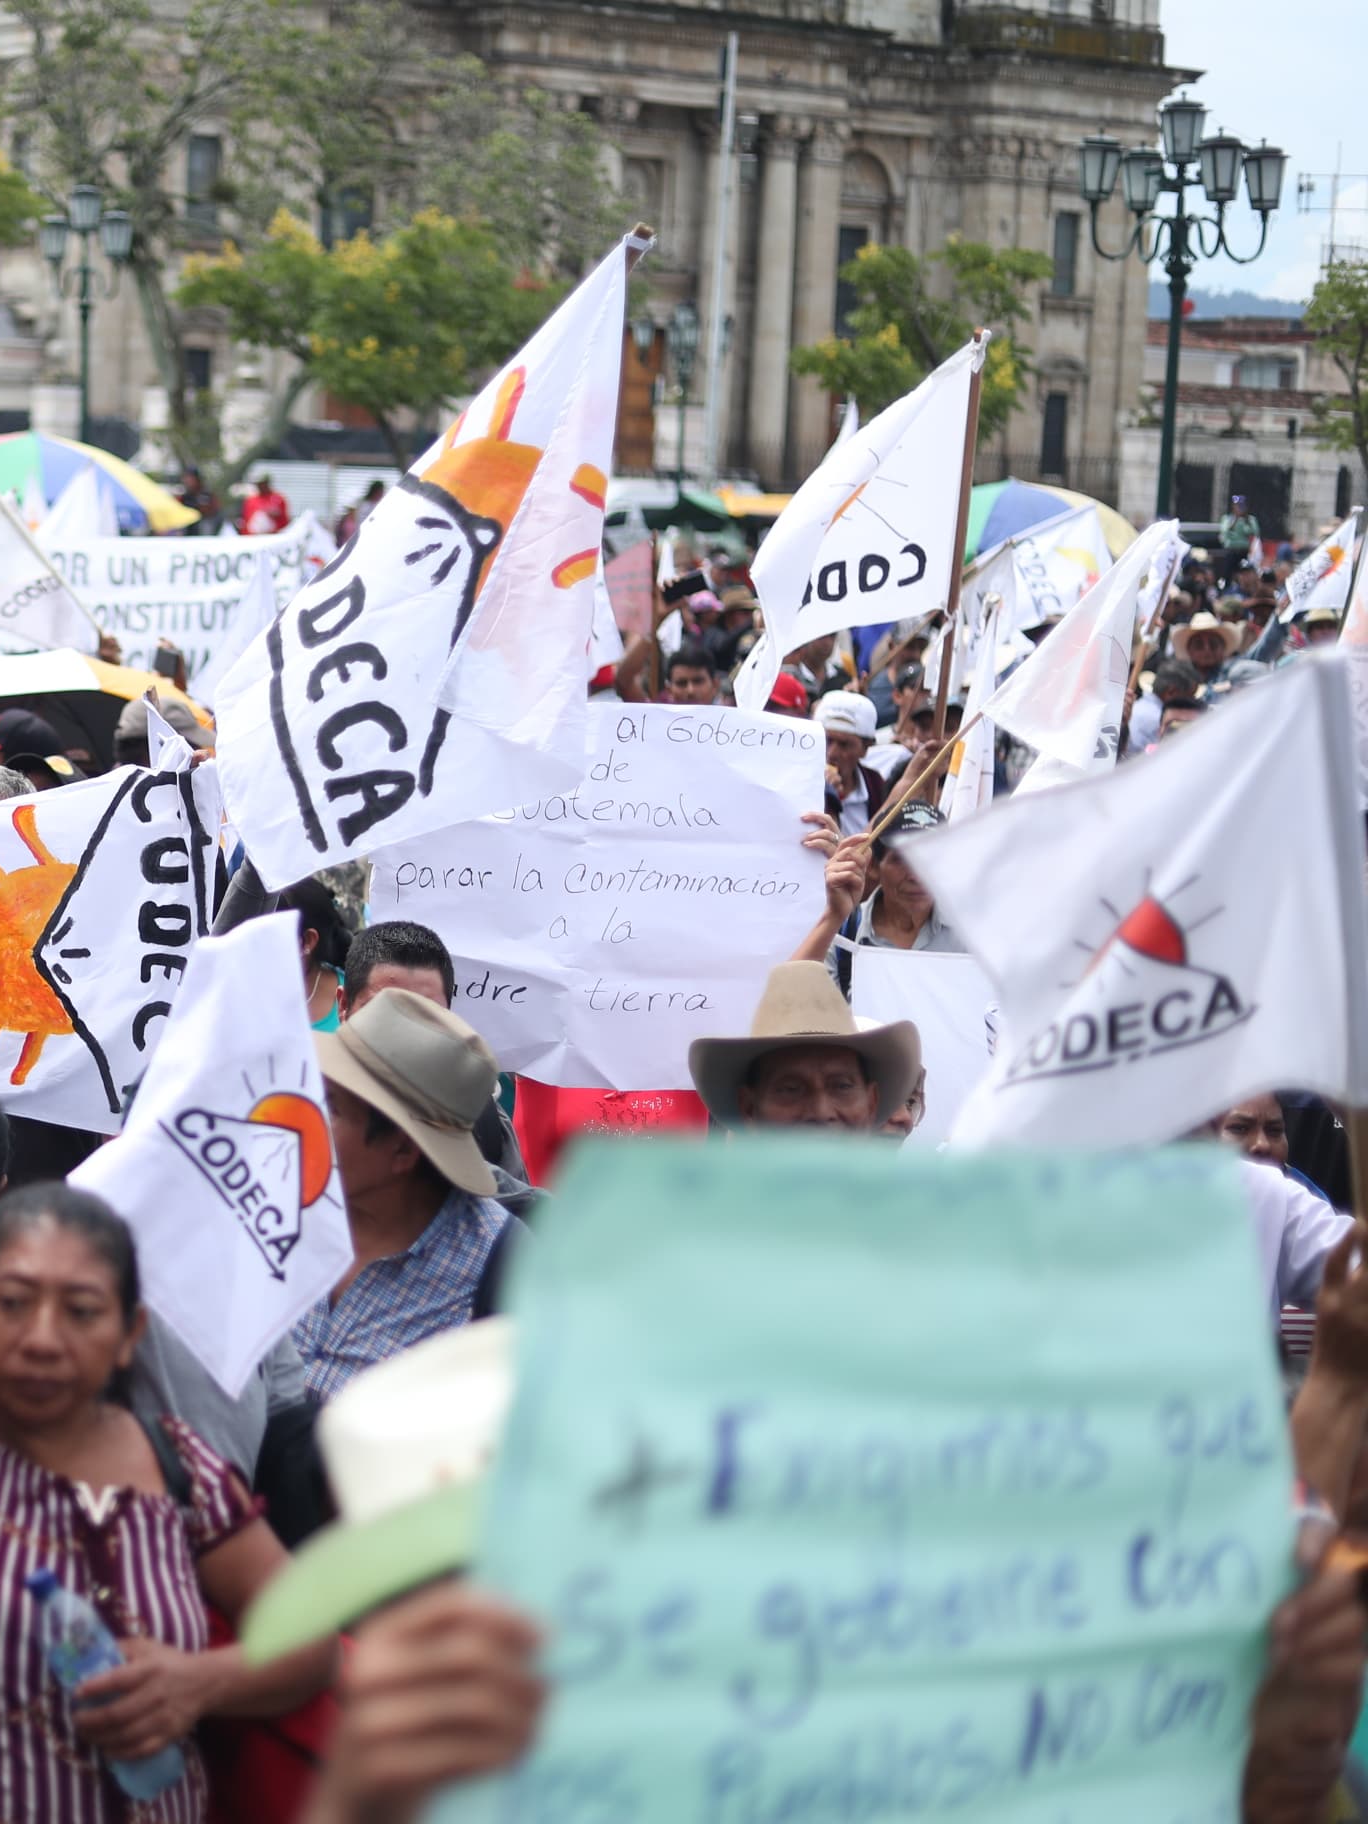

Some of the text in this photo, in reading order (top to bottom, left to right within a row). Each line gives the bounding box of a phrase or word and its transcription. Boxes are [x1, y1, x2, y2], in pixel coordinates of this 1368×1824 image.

[107, 554, 149, 586] UN
[616, 713, 816, 751] al Gobierno
[589, 748, 634, 783] de
[395, 860, 494, 905] parar
[512, 852, 544, 892] la
[548, 906, 640, 944] a la
[584, 976, 715, 1013] tierra
[173, 1107, 302, 1266] CODECA
